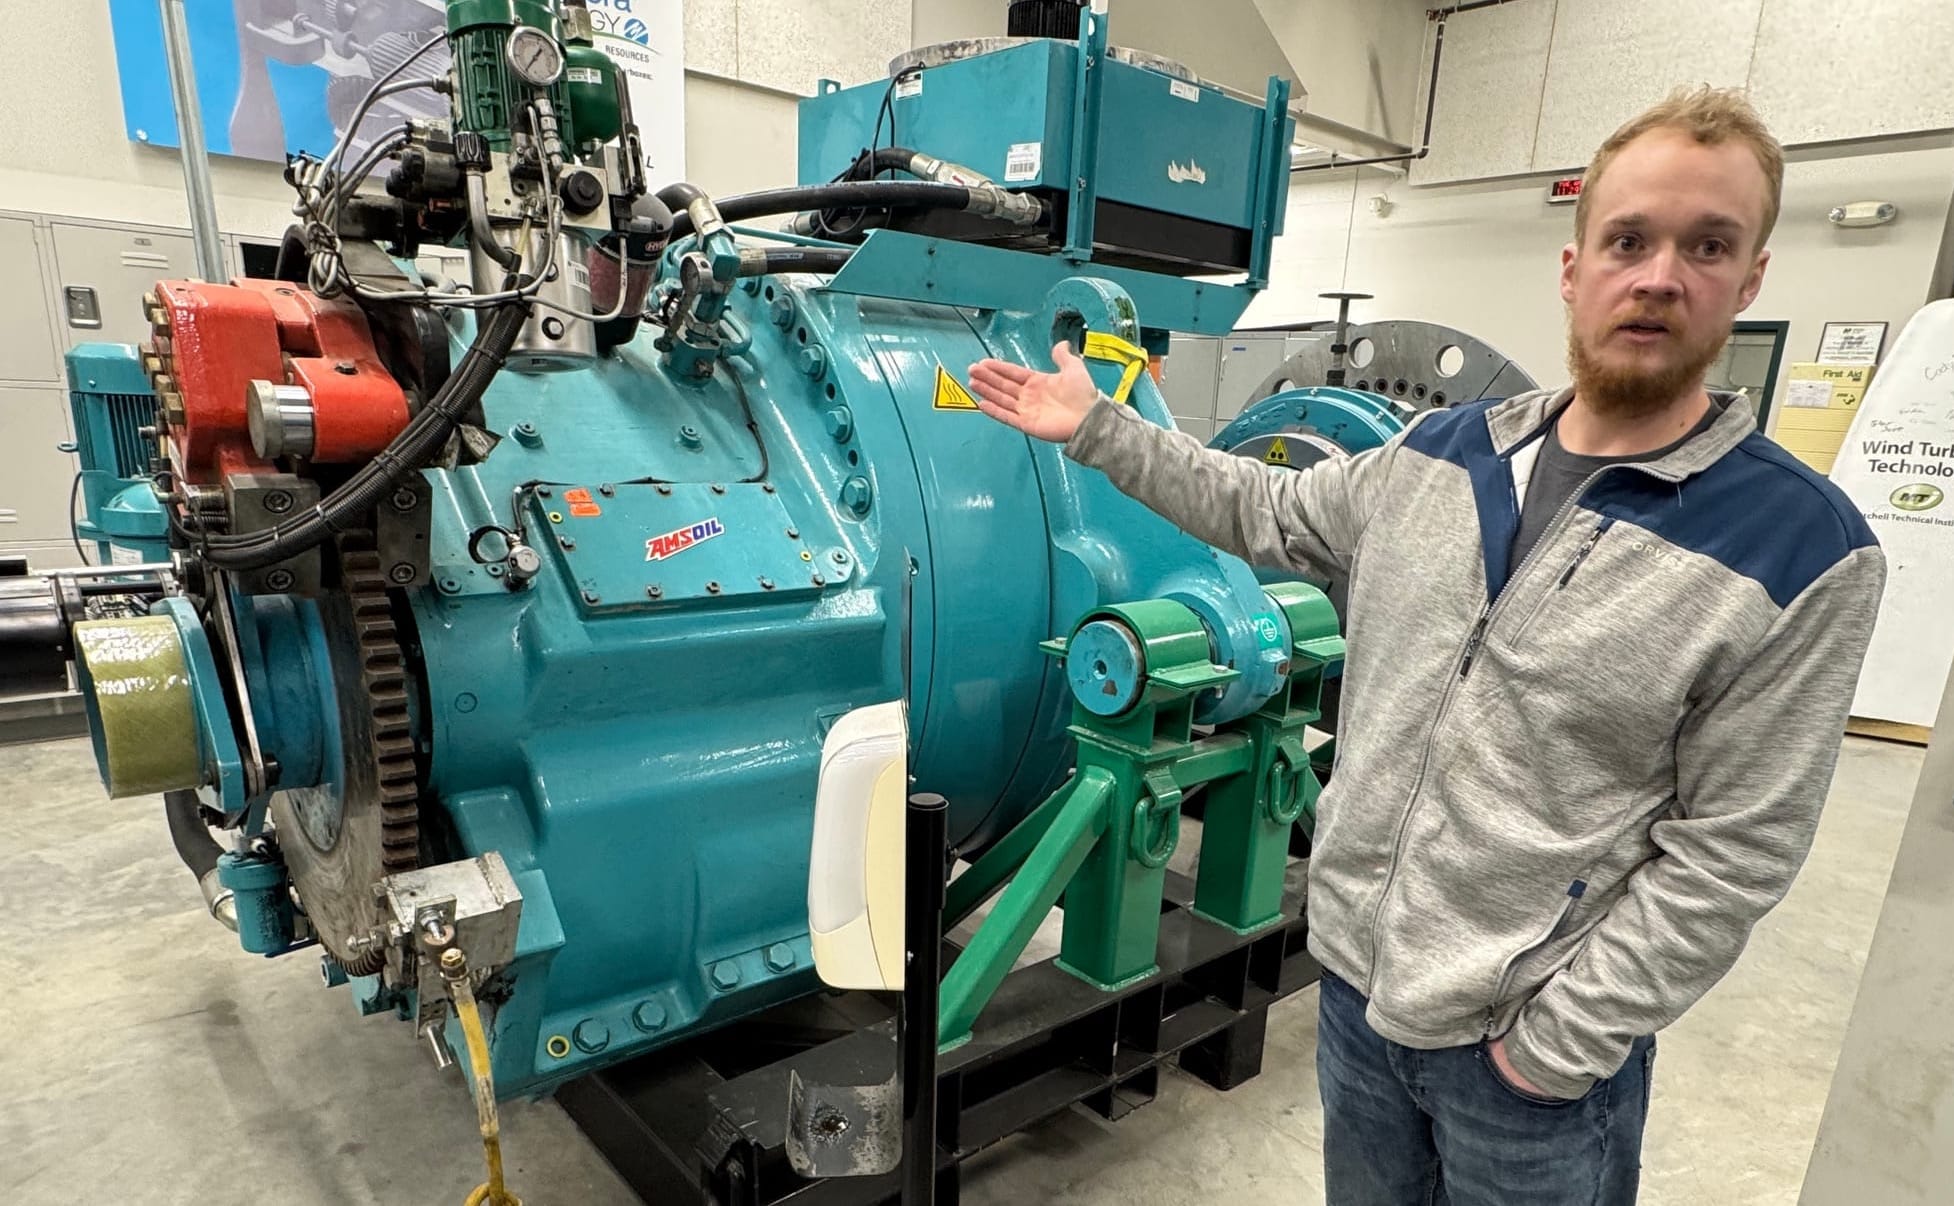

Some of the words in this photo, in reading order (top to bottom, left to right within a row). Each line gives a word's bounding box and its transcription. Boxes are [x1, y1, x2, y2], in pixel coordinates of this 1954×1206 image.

[605, 45, 650, 63] RESOURCES
[1823, 369, 1843, 378] First
[1846, 370, 1863, 378] Aid
[1862, 440, 1914, 455] Wind
[1867, 459, 1954, 477] Technolo
[1891, 513, 1933, 525] Technical
[647, 519, 722, 559] AMSOIL
